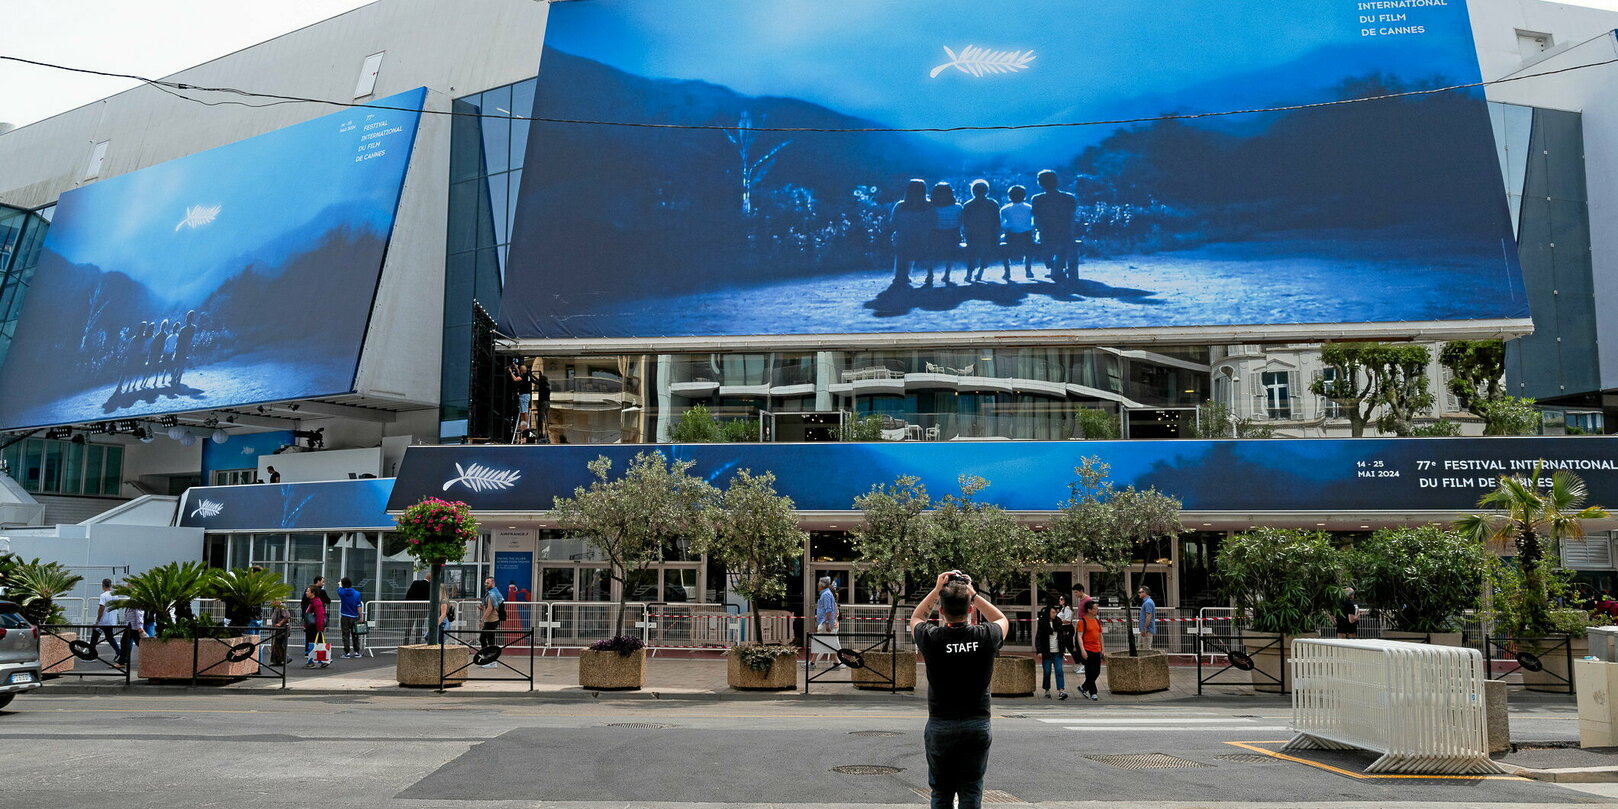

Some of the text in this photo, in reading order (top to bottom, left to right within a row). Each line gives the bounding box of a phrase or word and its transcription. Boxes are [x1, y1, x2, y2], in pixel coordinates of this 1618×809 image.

[1357, 0, 1448, 10] INTERNATIONAL
[1359, 13, 1406, 23] DU FILM
[1361, 25, 1425, 36] DE CANNES
[363, 120, 388, 131] FESTIVAL
[361, 126, 402, 141] INTERNATIONAL
[367, 141, 380, 150] FILM
[363, 149, 386, 160] CANNES
[1444, 460, 1506, 470] FESTIVAL
[1510, 460, 1618, 470] INTERNATIONAL
[1419, 478, 1438, 488] DU
[1442, 478, 1474, 487] FILM
[1479, 478, 1496, 487] DE
[946, 642, 979, 653] STAFF
